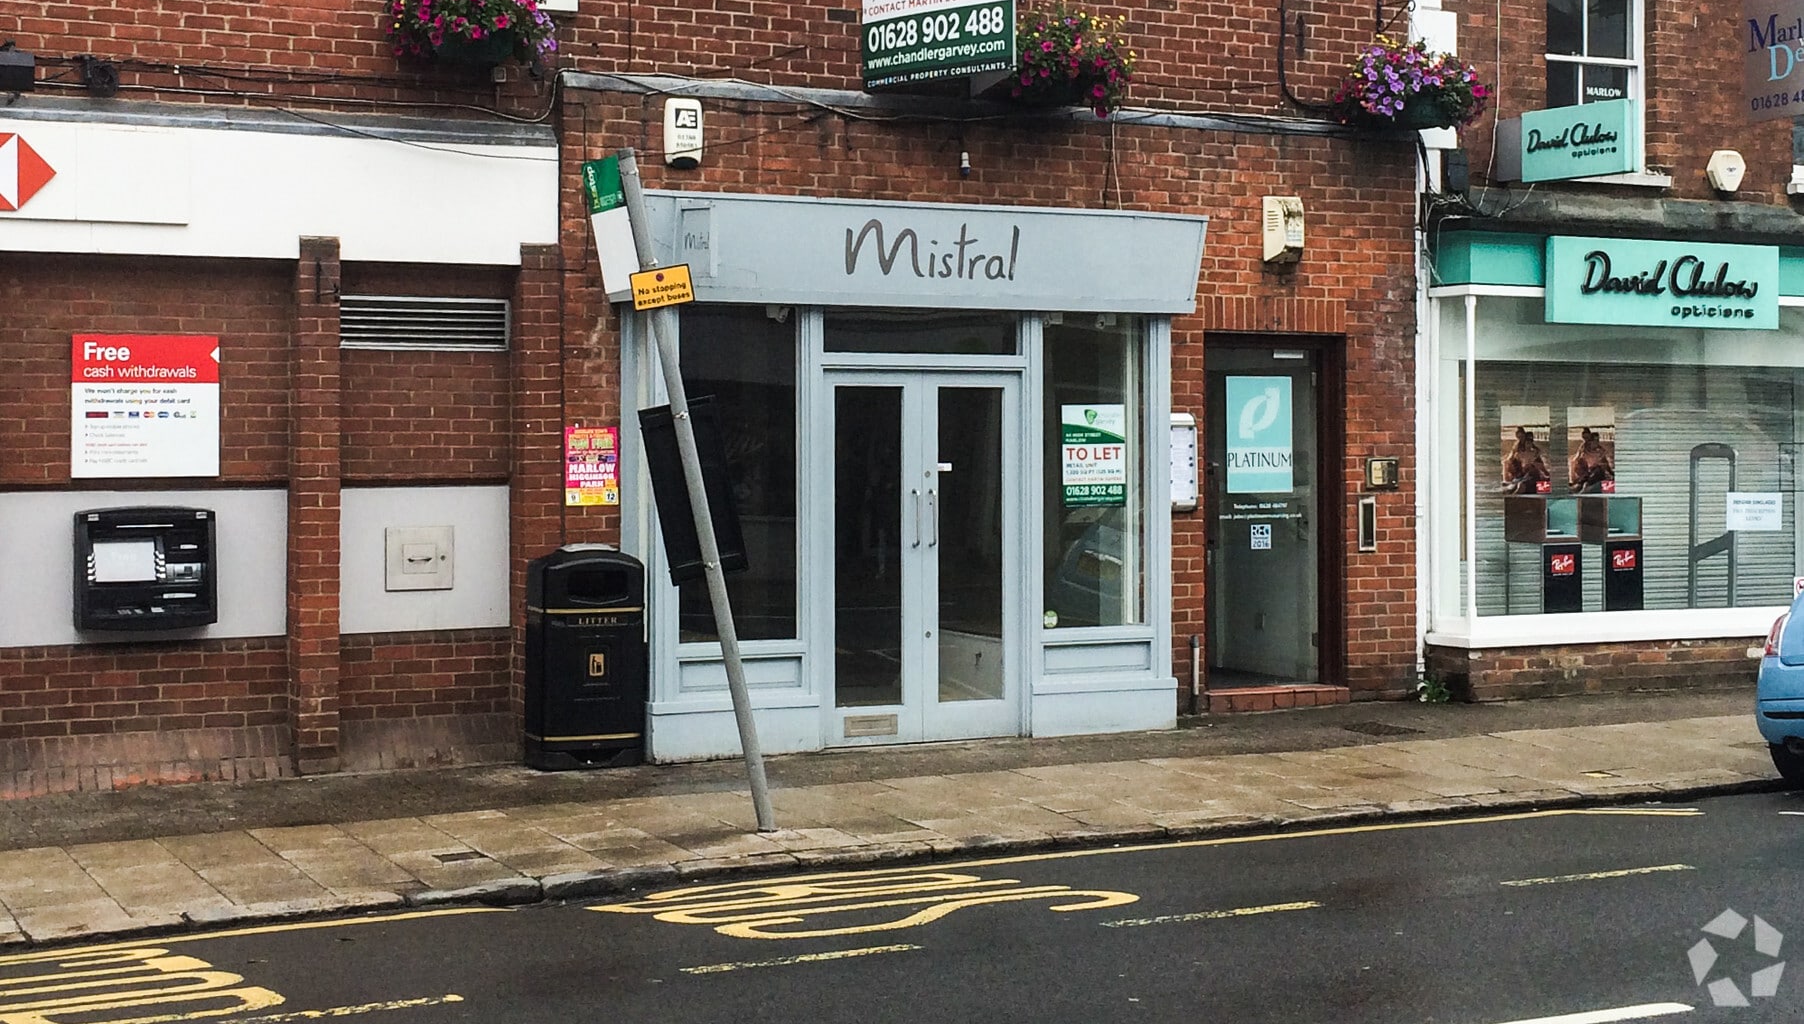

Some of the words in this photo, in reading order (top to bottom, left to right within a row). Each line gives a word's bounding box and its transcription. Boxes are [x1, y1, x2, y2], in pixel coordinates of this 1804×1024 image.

[868, 0, 906, 17] CONTACT
[868, 18, 918, 54] 01628
[922, 10, 960, 45] 902
[965, 5, 1005, 37] 488
[867, 37, 1006, 71] www.chandlergarvey.com
[867, 71, 909, 89] COMMERCIAL
[910, 65, 949, 82] PROPERTY
[950, 61, 1007, 78] CONSULTANTS
[1586, 86, 1622, 97] MARLOW
[1751, 92, 1789, 111] 01628
[1527, 127, 1569, 154] David
[1570, 122, 1618, 147] Clulow
[1571, 146, 1617, 158] opticians
[845, 218, 1020, 282] Mistral
[1581, 250, 1668, 297] David
[1669, 254, 1759, 299] Clulow
[638, 286, 650, 296] No
[652, 282, 687, 295] stopping
[638, 296, 666, 307] except
[667, 291, 690, 302] buses
[1671, 304, 1756, 321] opticians
[83, 341, 131, 361] Free
[83, 364, 115, 378] cash
[117, 364, 198, 378] withdrawals
[1066, 447, 1088, 461] TO
[1093, 447, 1122, 460] LET
[1227, 452, 1292, 468] PLATINUM
[569, 463, 616, 473] MARLOW
[580, 480, 604, 488] PARK
[1066, 485, 1090, 496] 01628
[1090, 485, 1106, 495] 902
[1107, 485, 1123, 495] 488
[607, 492, 616, 501] 12
[579, 616, 618, 626] LITTER
